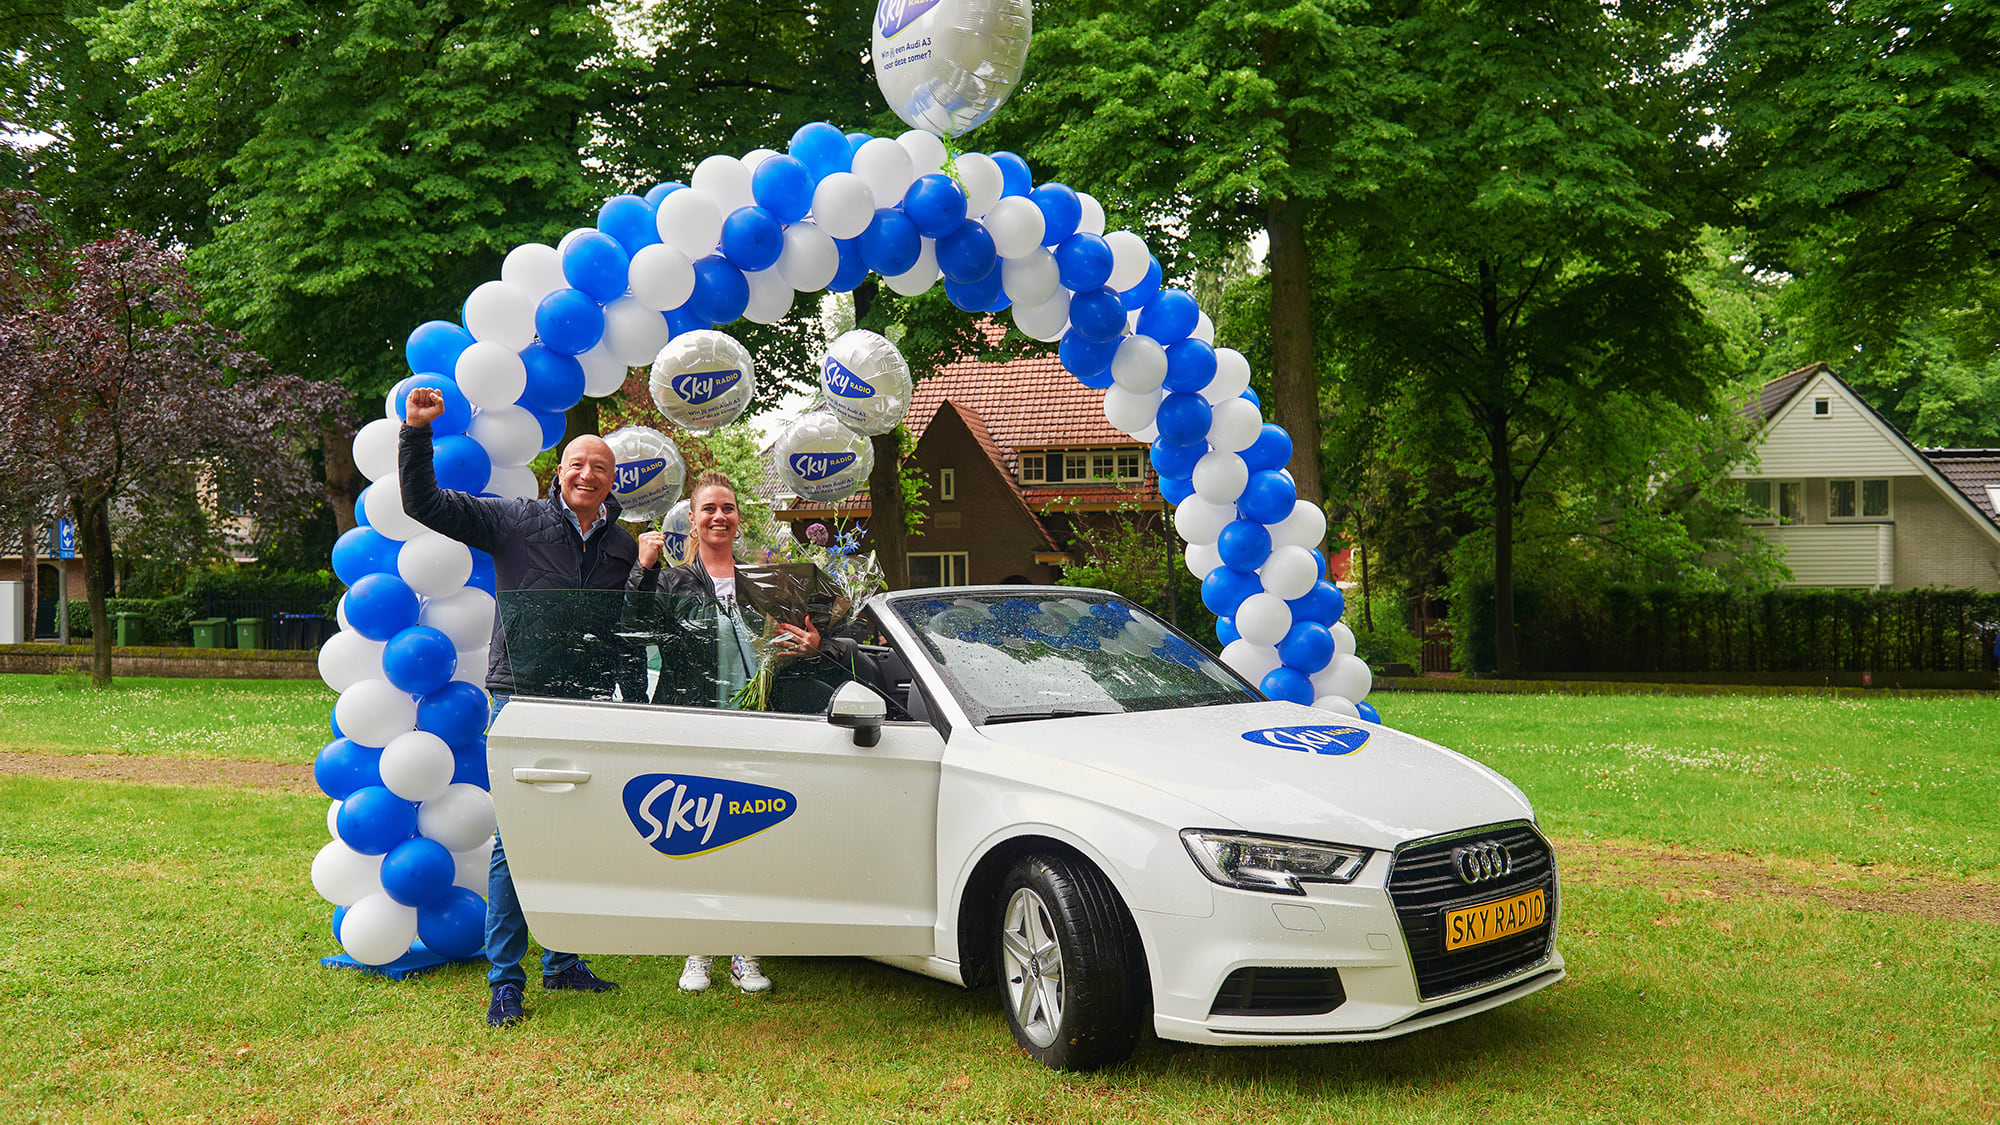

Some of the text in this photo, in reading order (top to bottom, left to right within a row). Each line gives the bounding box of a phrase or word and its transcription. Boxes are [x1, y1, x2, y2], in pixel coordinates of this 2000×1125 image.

[895, 45, 905, 54] een
[906, 40, 921, 50] Audi
[922, 37, 932, 47] A3
[884, 49, 932, 70] voor deze zomer?
[679, 372, 739, 401] Sky RADIO
[825, 363, 871, 395] Sky RADIO
[641, 461, 664, 474] RADIO
[796, 455, 853, 478] Sky RADIO
[1263, 730, 1350, 754] Sky
[639, 779, 787, 845] Sky RADIO
[1452, 895, 1542, 944] SKY RADIO
